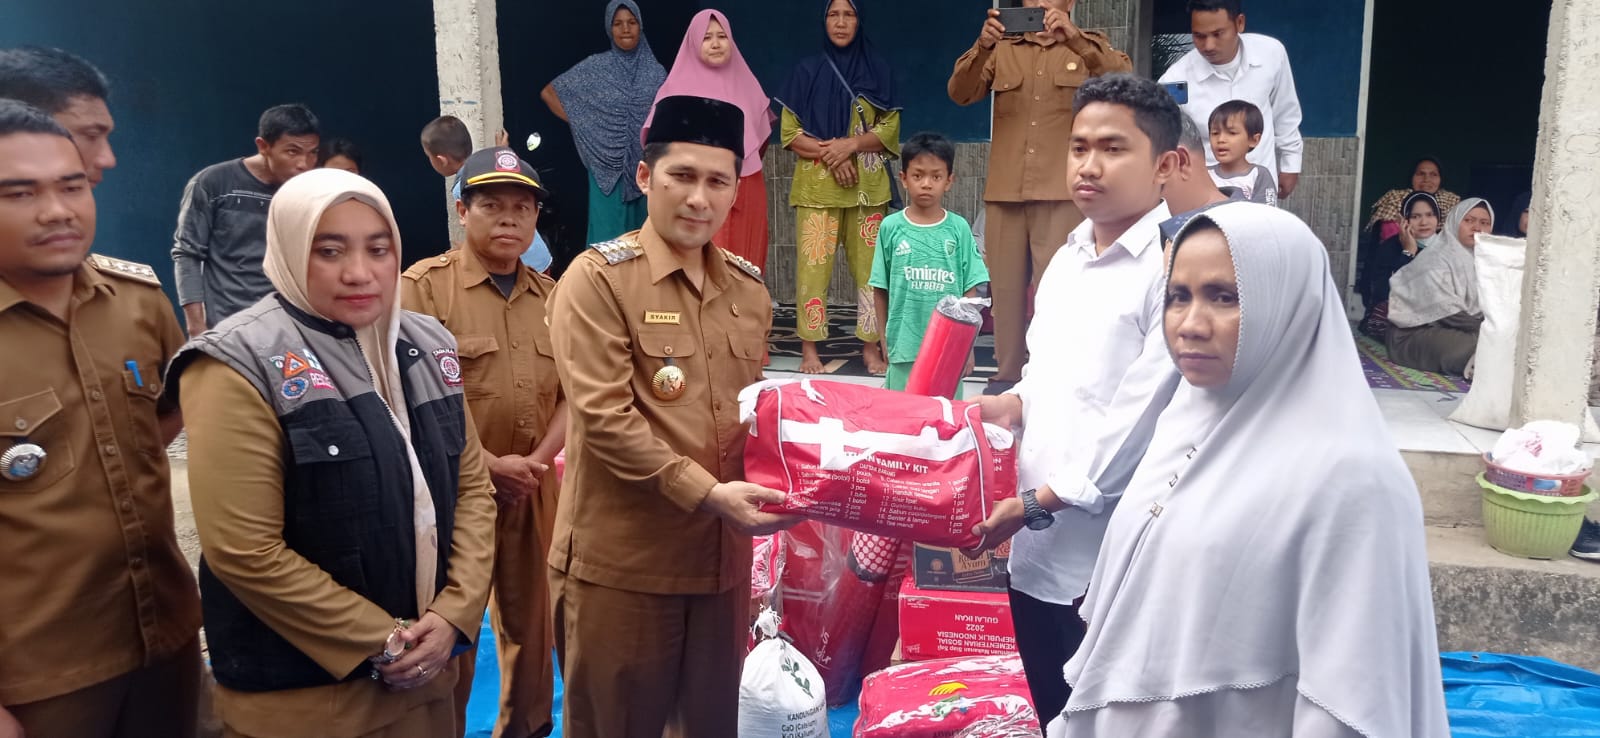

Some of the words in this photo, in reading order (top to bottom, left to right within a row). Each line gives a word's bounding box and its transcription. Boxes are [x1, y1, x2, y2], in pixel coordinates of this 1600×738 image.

[903, 264, 955, 284] Emirates
[911, 281, 923, 290] FLY
[913, 464, 929, 474] KIT
[955, 614, 973, 622] IKAN
[937, 631, 977, 639] INDONESIA
[978, 633, 1015, 642] REPUBLIK
[937, 637, 963, 646] SOSIAL
[964, 639, 1015, 650] KEMENTERIAN
